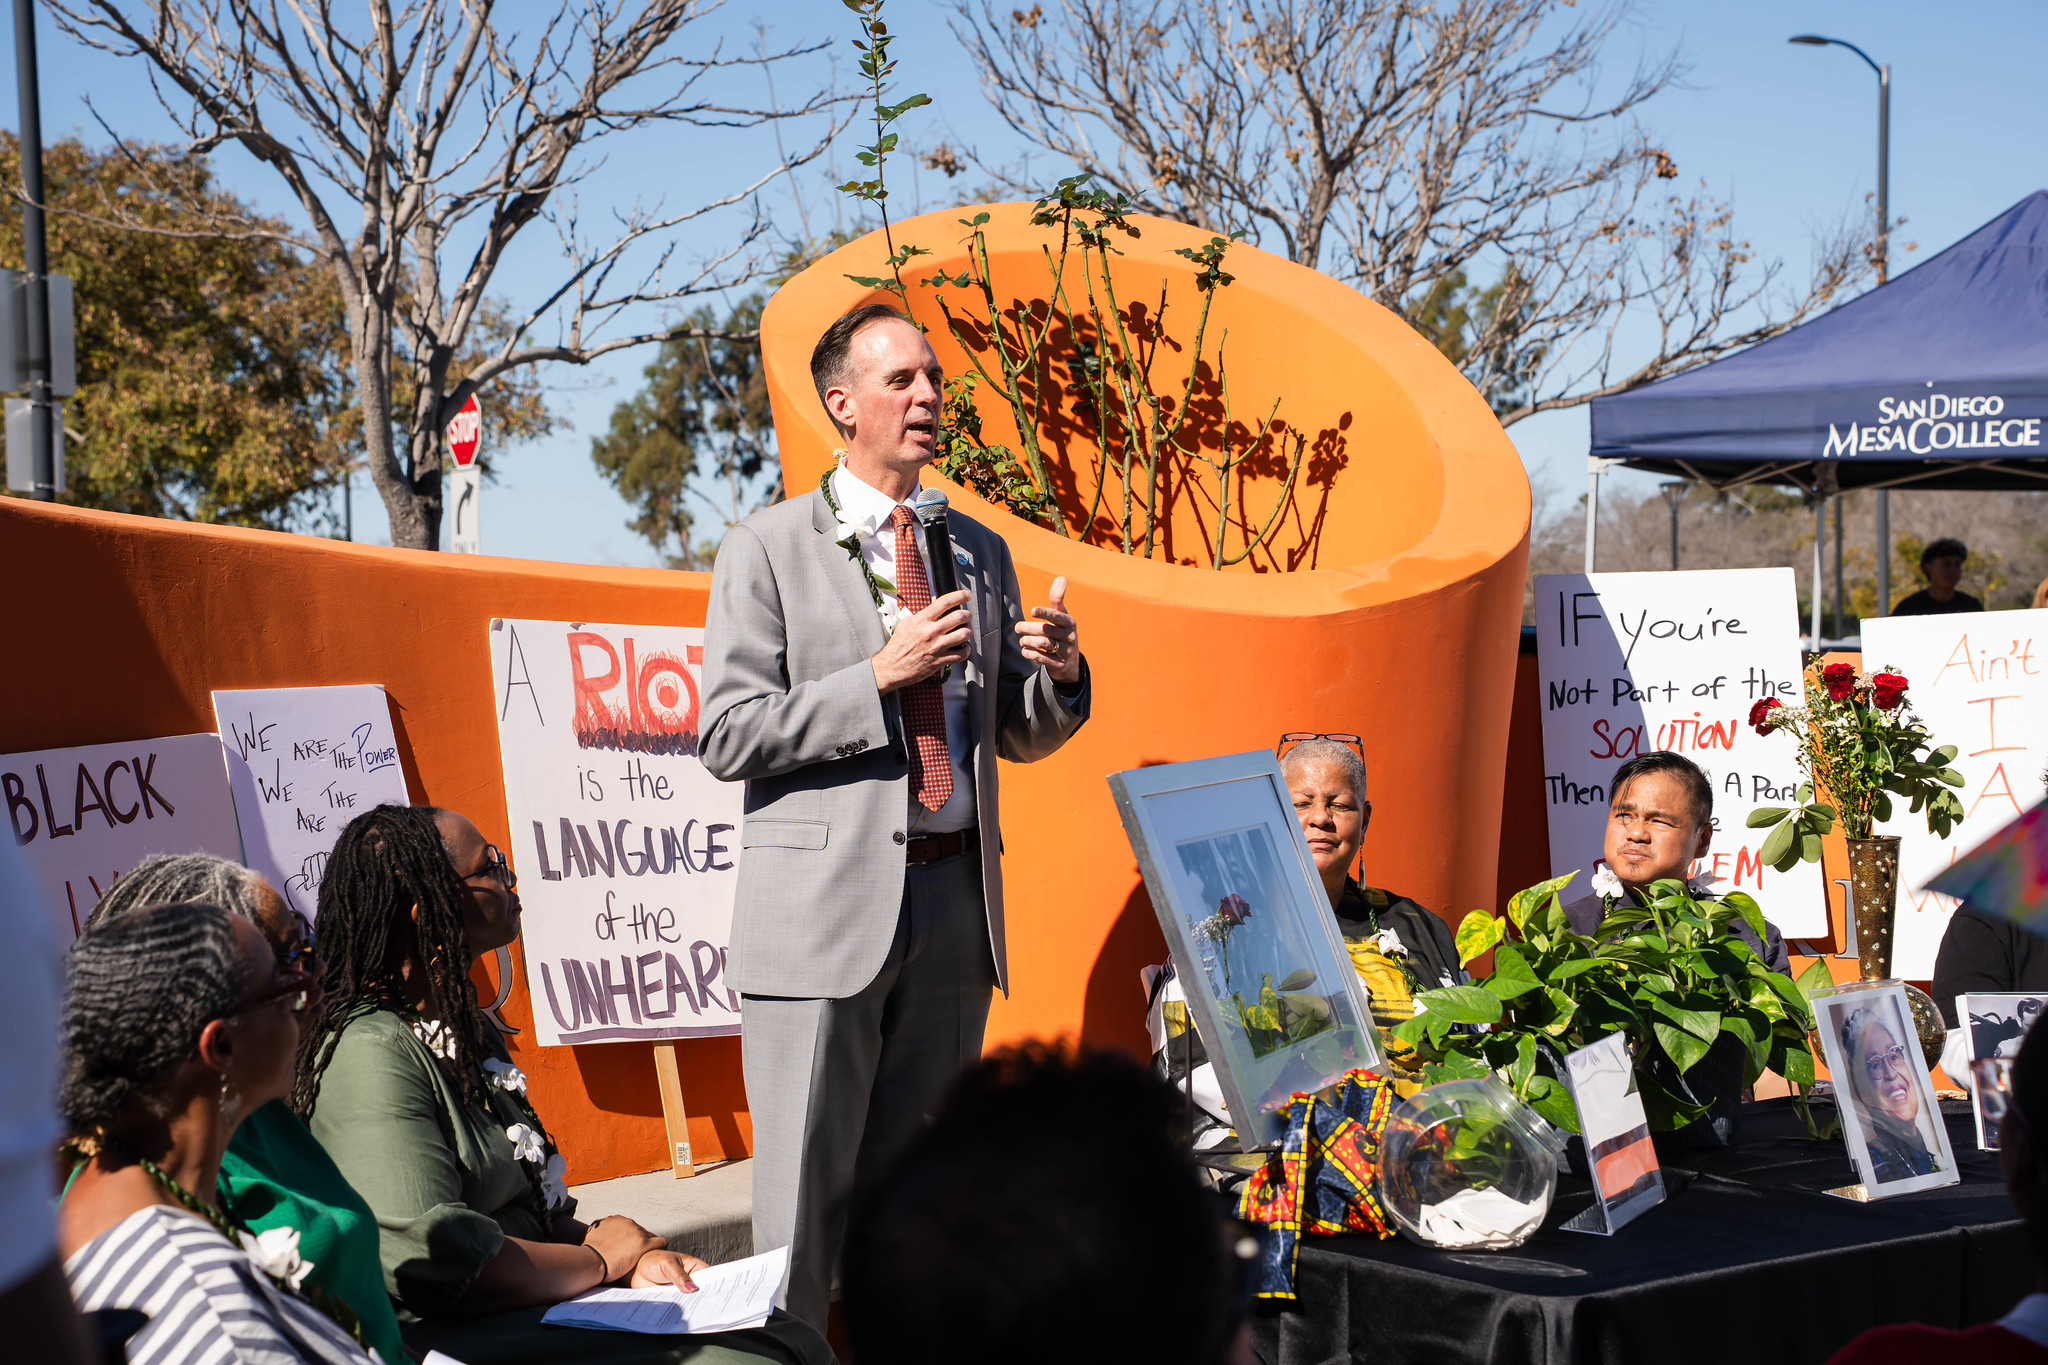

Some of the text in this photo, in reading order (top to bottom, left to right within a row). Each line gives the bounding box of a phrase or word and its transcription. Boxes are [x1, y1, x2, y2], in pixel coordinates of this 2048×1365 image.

[449, 411, 479, 445] STOP
[1558, 591, 1602, 647] IF
[1932, 633, 2041, 686] Ain't
[501, 624, 703, 757] A RIO
[1549, 667, 1798, 711] Not Part of the
[293, 738, 329, 762] ARE
[1967, 695, 2028, 757] I
[1, 752, 175, 847] BLACK
[578, 758, 675, 802] is the
[1545, 772, 1604, 805] Then
[1725, 772, 1743, 798] A
[532, 818, 736, 882] LANGUAGE
[594, 890, 682, 946] of the
